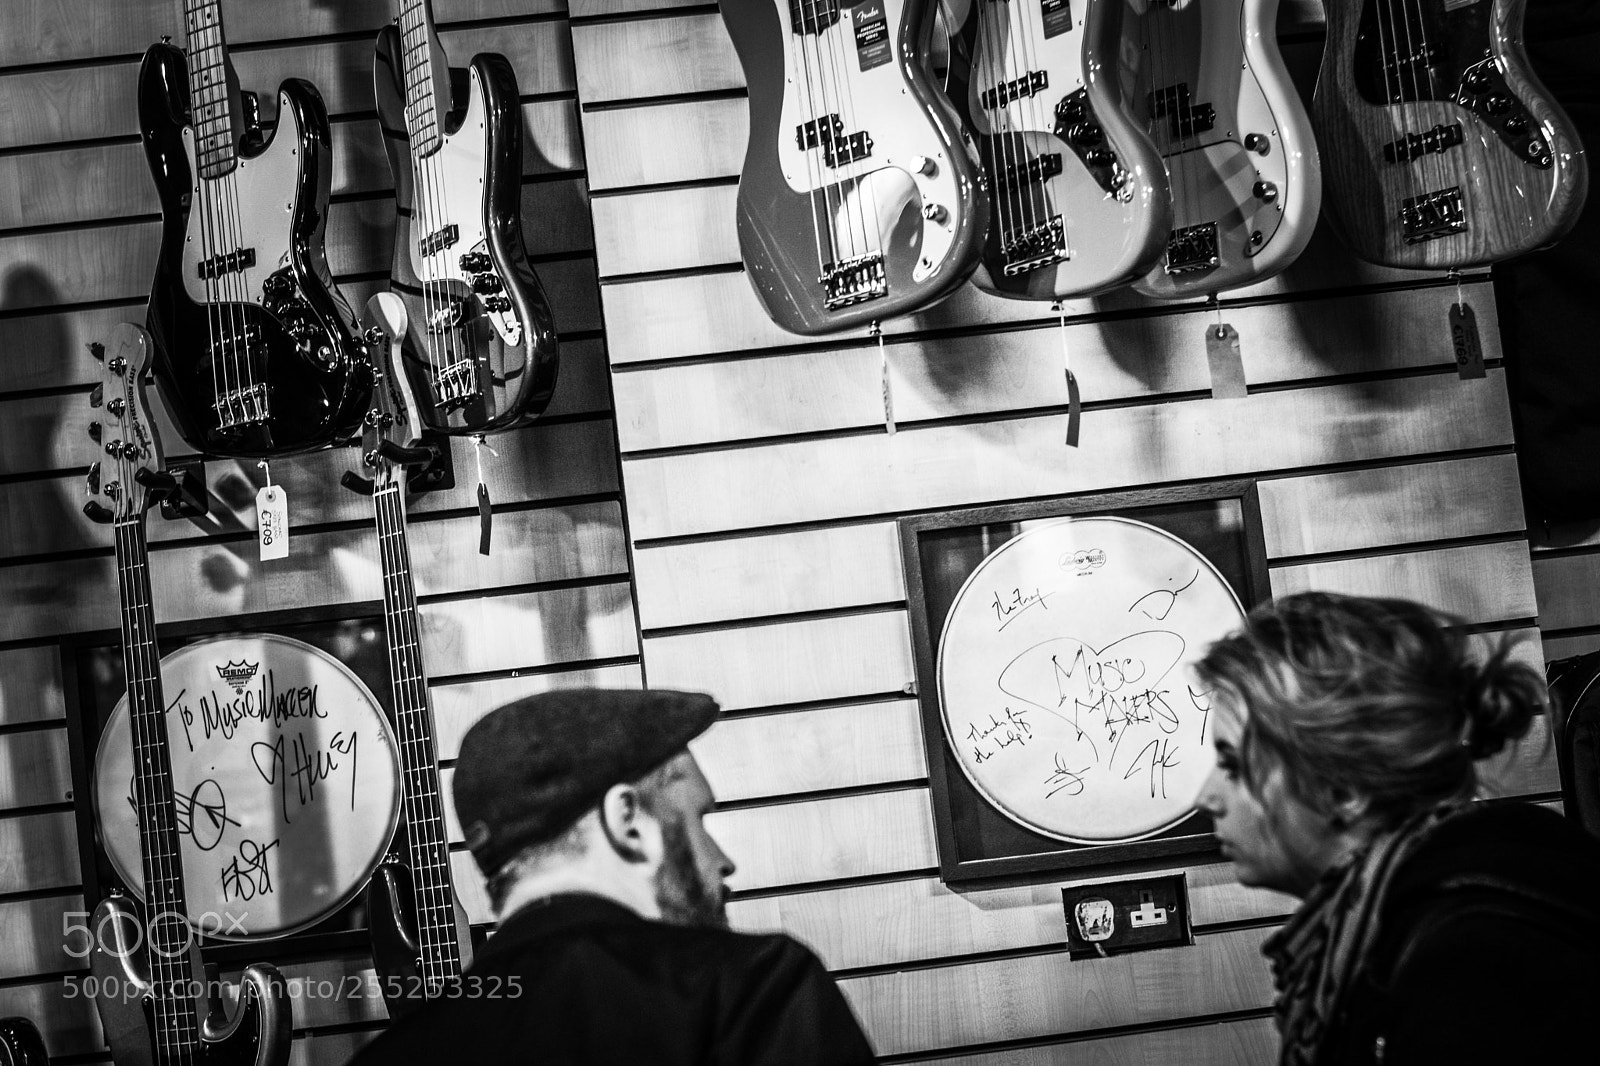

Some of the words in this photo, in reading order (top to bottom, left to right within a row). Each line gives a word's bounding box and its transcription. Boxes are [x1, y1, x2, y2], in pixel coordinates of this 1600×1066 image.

[128, 364, 137, 385] BASS
[128, 385, 138, 421] PRECISION
[222, 667, 254, 677] REMO
